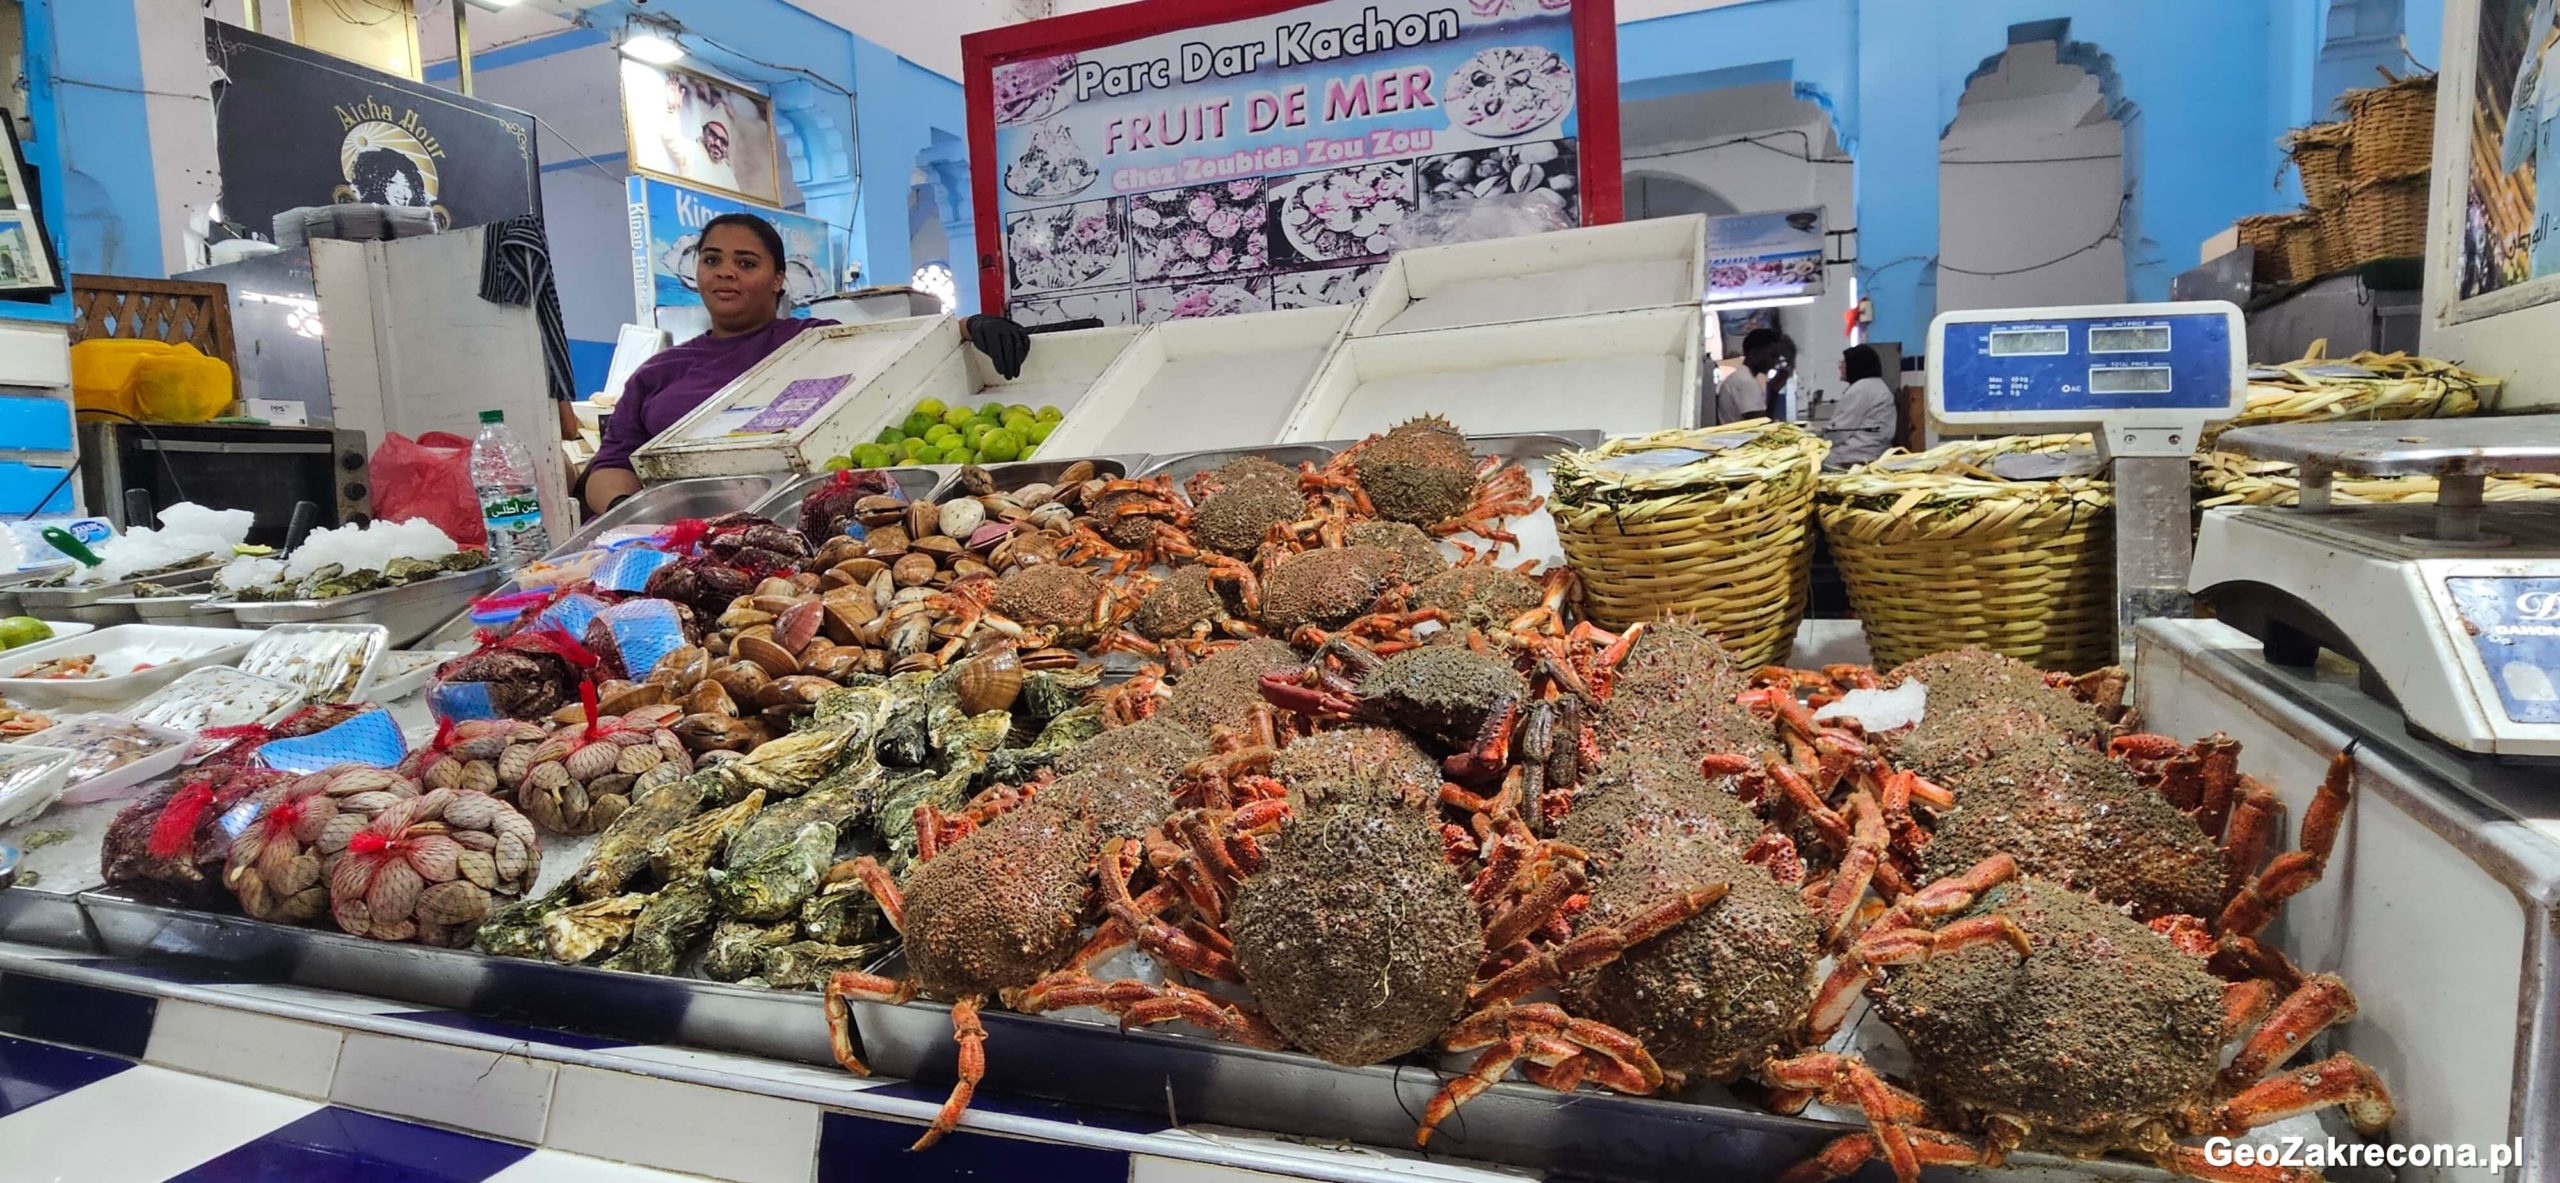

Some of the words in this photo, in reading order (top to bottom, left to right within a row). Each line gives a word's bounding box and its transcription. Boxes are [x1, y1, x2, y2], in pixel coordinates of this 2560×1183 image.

[1076, 56, 1169, 101] Parc
[1181, 41, 1264, 83] Dar
[1276, 7, 1459, 67] Kachon
[334, 94, 393, 131] Aicha
[398, 109, 446, 159] Nour
[1105, 99, 1231, 155] FRUIT
[1248, 86, 1306, 134] DE
[1324, 68, 1436, 121] MER
[1112, 164, 1178, 192] Chez
[1181, 147, 1299, 184] Zoubida
[1306, 137, 1364, 164] Zou
[1370, 128, 1432, 156] Zou
[629, 202, 646, 250] Kinan
[676, 189, 722, 227] Kin
